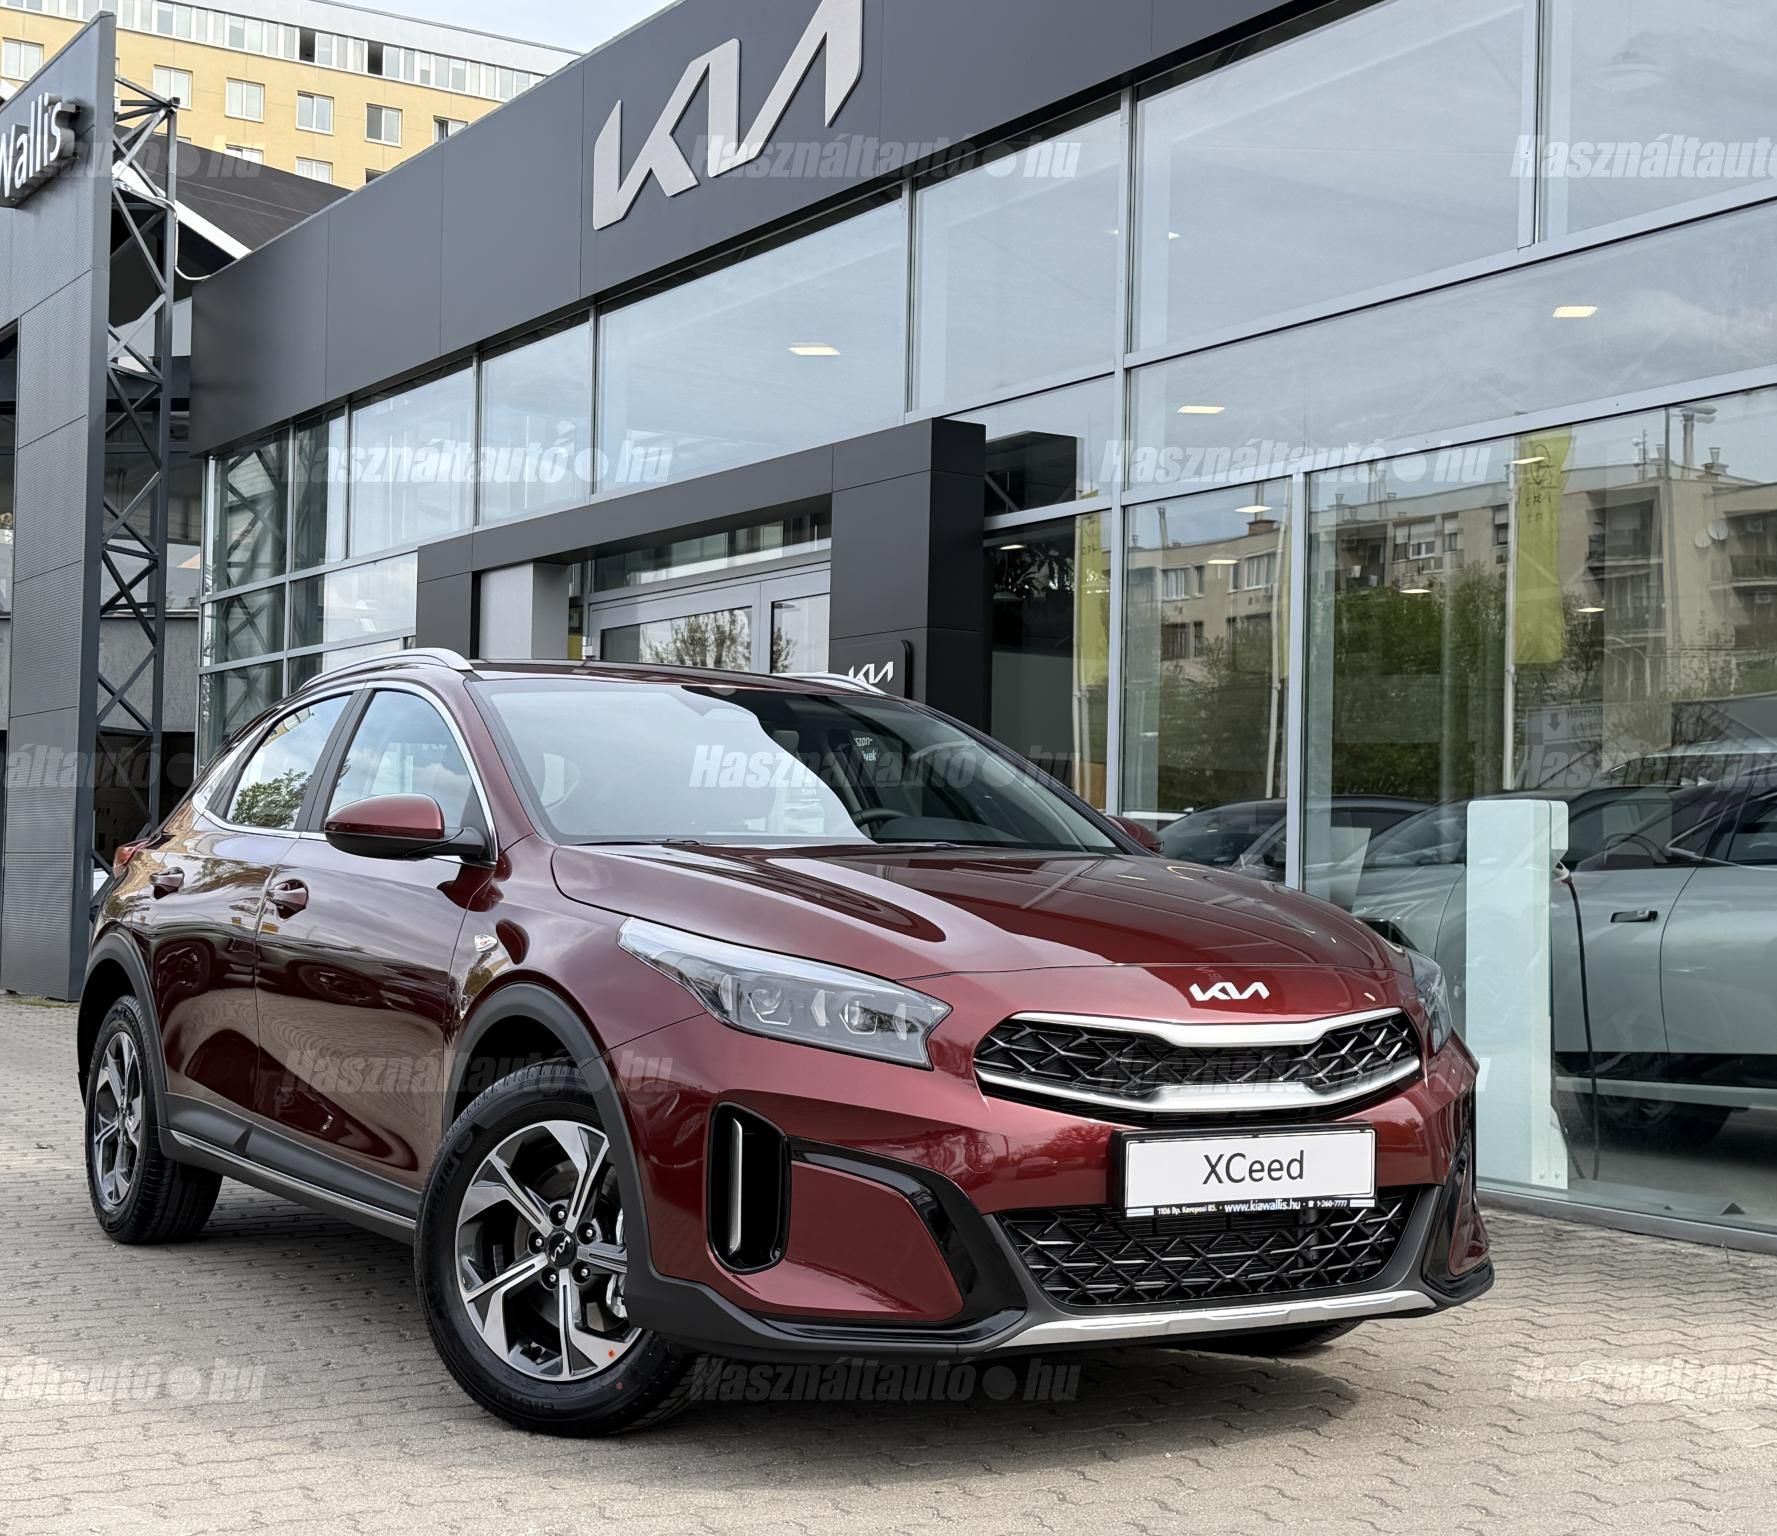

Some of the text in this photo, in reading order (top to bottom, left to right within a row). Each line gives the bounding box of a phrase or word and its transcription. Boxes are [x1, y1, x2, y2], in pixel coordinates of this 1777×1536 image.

[593, 0, 862, 231] KIA
[1189, 981, 1270, 1002] KIA
[1202, 1149, 1304, 1185] XCeed
[1224, 1198, 1301, 1214] www.kiawallis.hu
